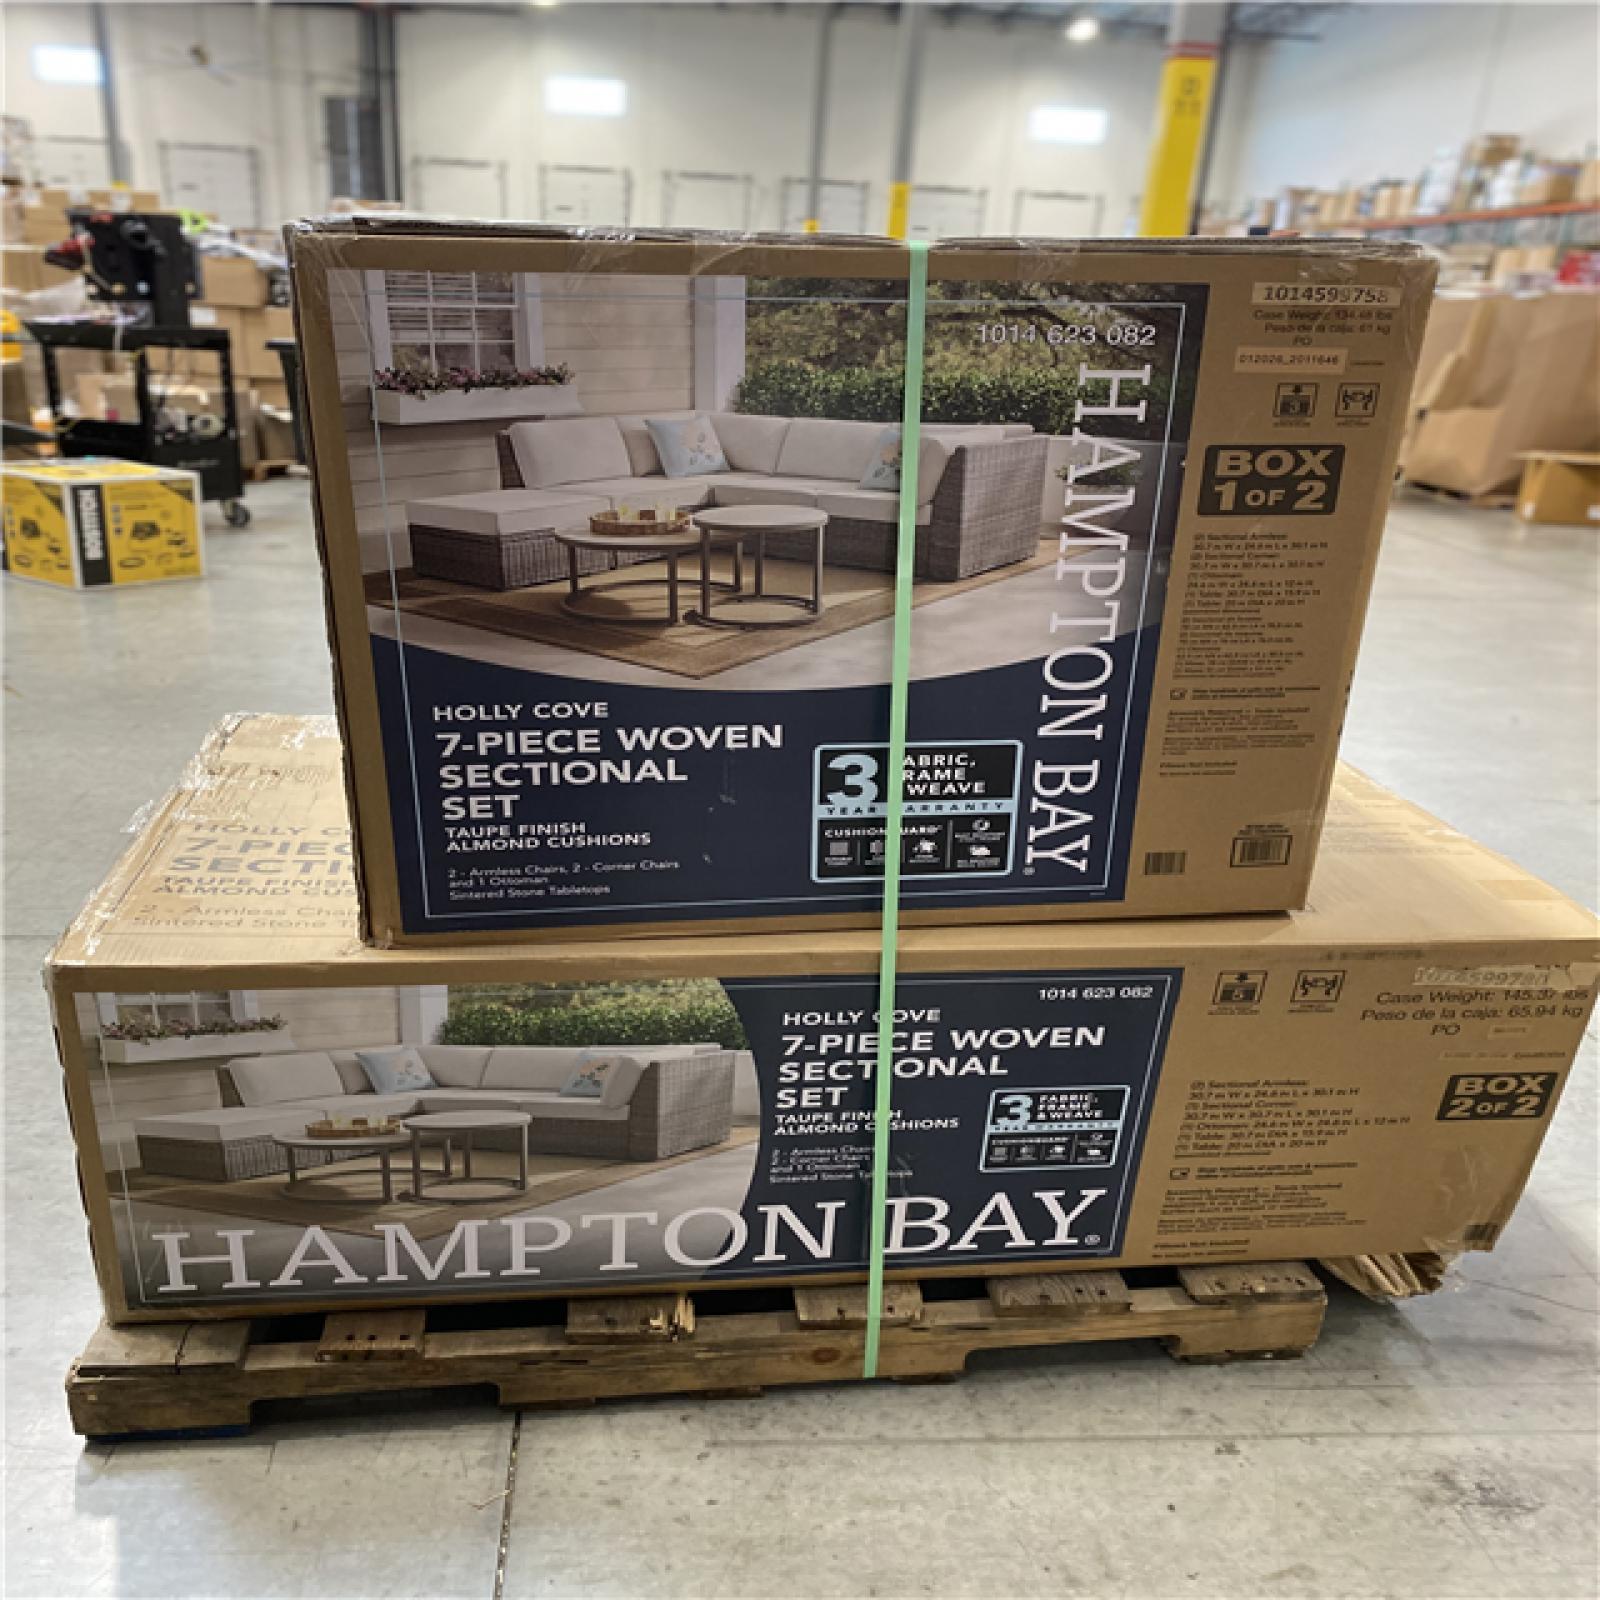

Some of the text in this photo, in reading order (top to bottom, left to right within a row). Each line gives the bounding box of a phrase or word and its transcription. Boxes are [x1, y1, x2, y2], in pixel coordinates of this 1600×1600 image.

[977, 325, 1156, 345] 1014 623 082
[1214, 449, 1334, 477] BOX
[1215, 480, 1327, 511] 1 OF 2
[1037, 362, 1151, 741] HAMPTON
[433, 702, 608, 721] HOLLY COVE
[435, 724, 783, 758] 7-PIECE WOVEN
[440, 758, 688, 789] SECTIONAL
[827, 754, 879, 806] 3
[903, 769, 966, 781] RAME
[907, 781, 986, 796] WEAVE
[442, 794, 520, 821] SET
[193, 824, 307, 835] HOLLY
[445, 821, 586, 839] TAUPE FINISH
[446, 832, 652, 853] ALMOND CUSHIONS
[168, 856, 353, 875] SECTI
[470, 866, 521, 876] Armless
[592, 862, 636, 872] Corner
[640, 859, 680, 870] Chairs
[164, 877, 251, 886] TAUPE
[449, 879, 474, 888] and
[152, 887, 291, 896] ALMOND
[449, 889, 504, 900] Sintered
[508, 887, 545, 897] Stone
[184, 905, 287, 916] Armless
[1039, 989, 1078, 1001] 1014
[1376, 991, 1424, 1005] Case
[783, 1010, 864, 1026] HOLLY
[1360, 1009, 1408, 1021] Peso
[1412, 1007, 1437, 1020] de
[1440, 1007, 1457, 1019] la
[1562, 1004, 1584, 1019] kg
[949, 1025, 1107, 1051] WOVEN
[1431, 1024, 1462, 1036] PO
[778, 1055, 1009, 1083] SECTONAL
[1455, 1075, 1549, 1095] BOX
[775, 1087, 849, 1108] SET
[1445, 1095, 1542, 1118] 2 OF 2
[775, 1113, 833, 1124] TAUPE
[995, 1094, 1034, 1125] 3
[774, 1117, 960, 1136] ALMOND CSHIONS
[151, 1201, 846, 1292] HAMPTON
